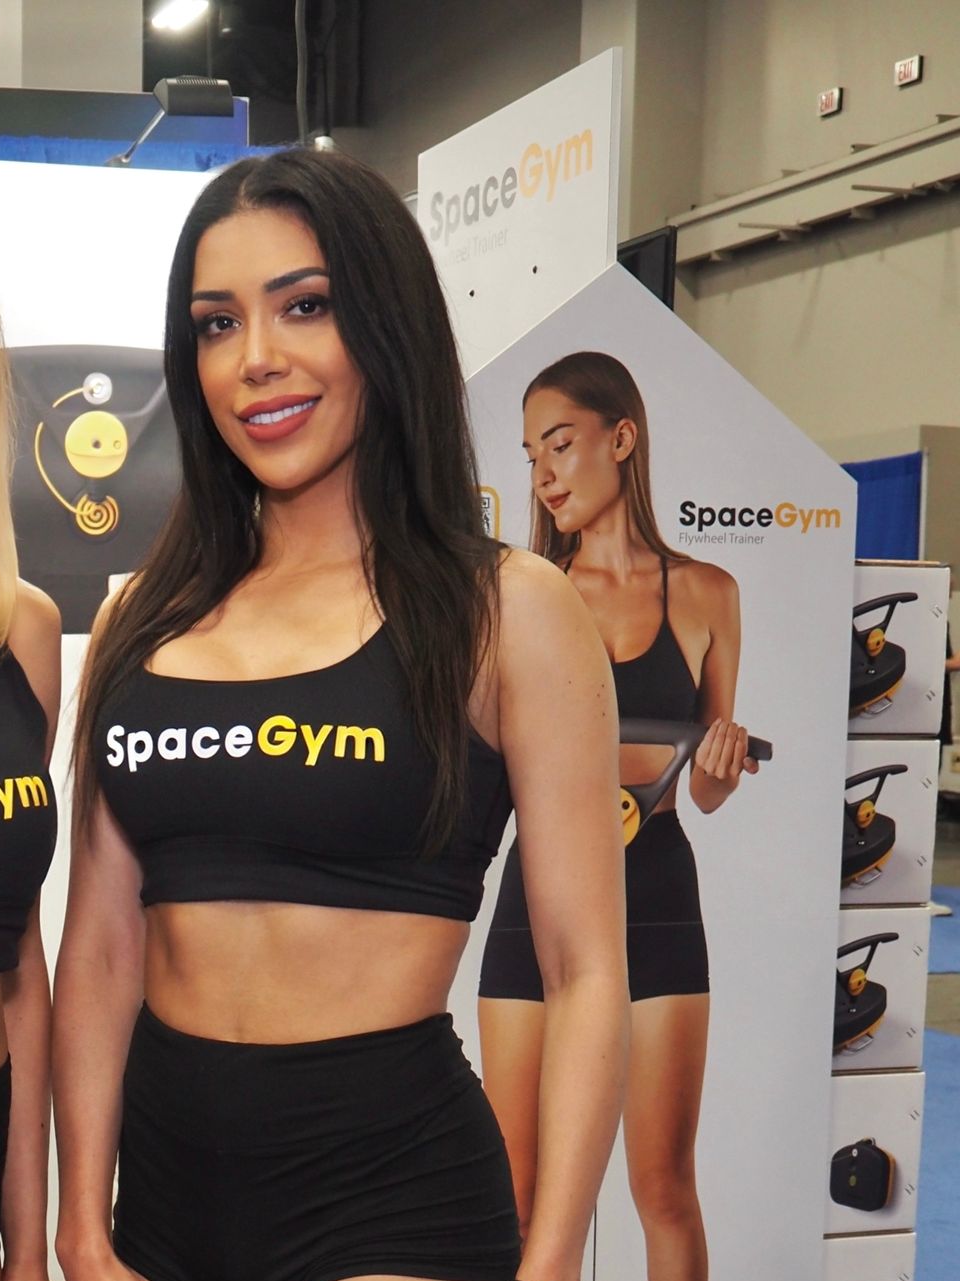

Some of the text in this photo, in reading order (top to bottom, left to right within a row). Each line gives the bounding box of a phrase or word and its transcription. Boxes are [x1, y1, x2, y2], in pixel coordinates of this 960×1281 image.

[898, 60, 913, 82] EXIT
[430, 128, 593, 247] SpaceGym
[679, 500, 841, 534] SpaceGym
[679, 532, 765, 546] Flywheel Trainer
[106, 714, 385, 772] SpaceGym
